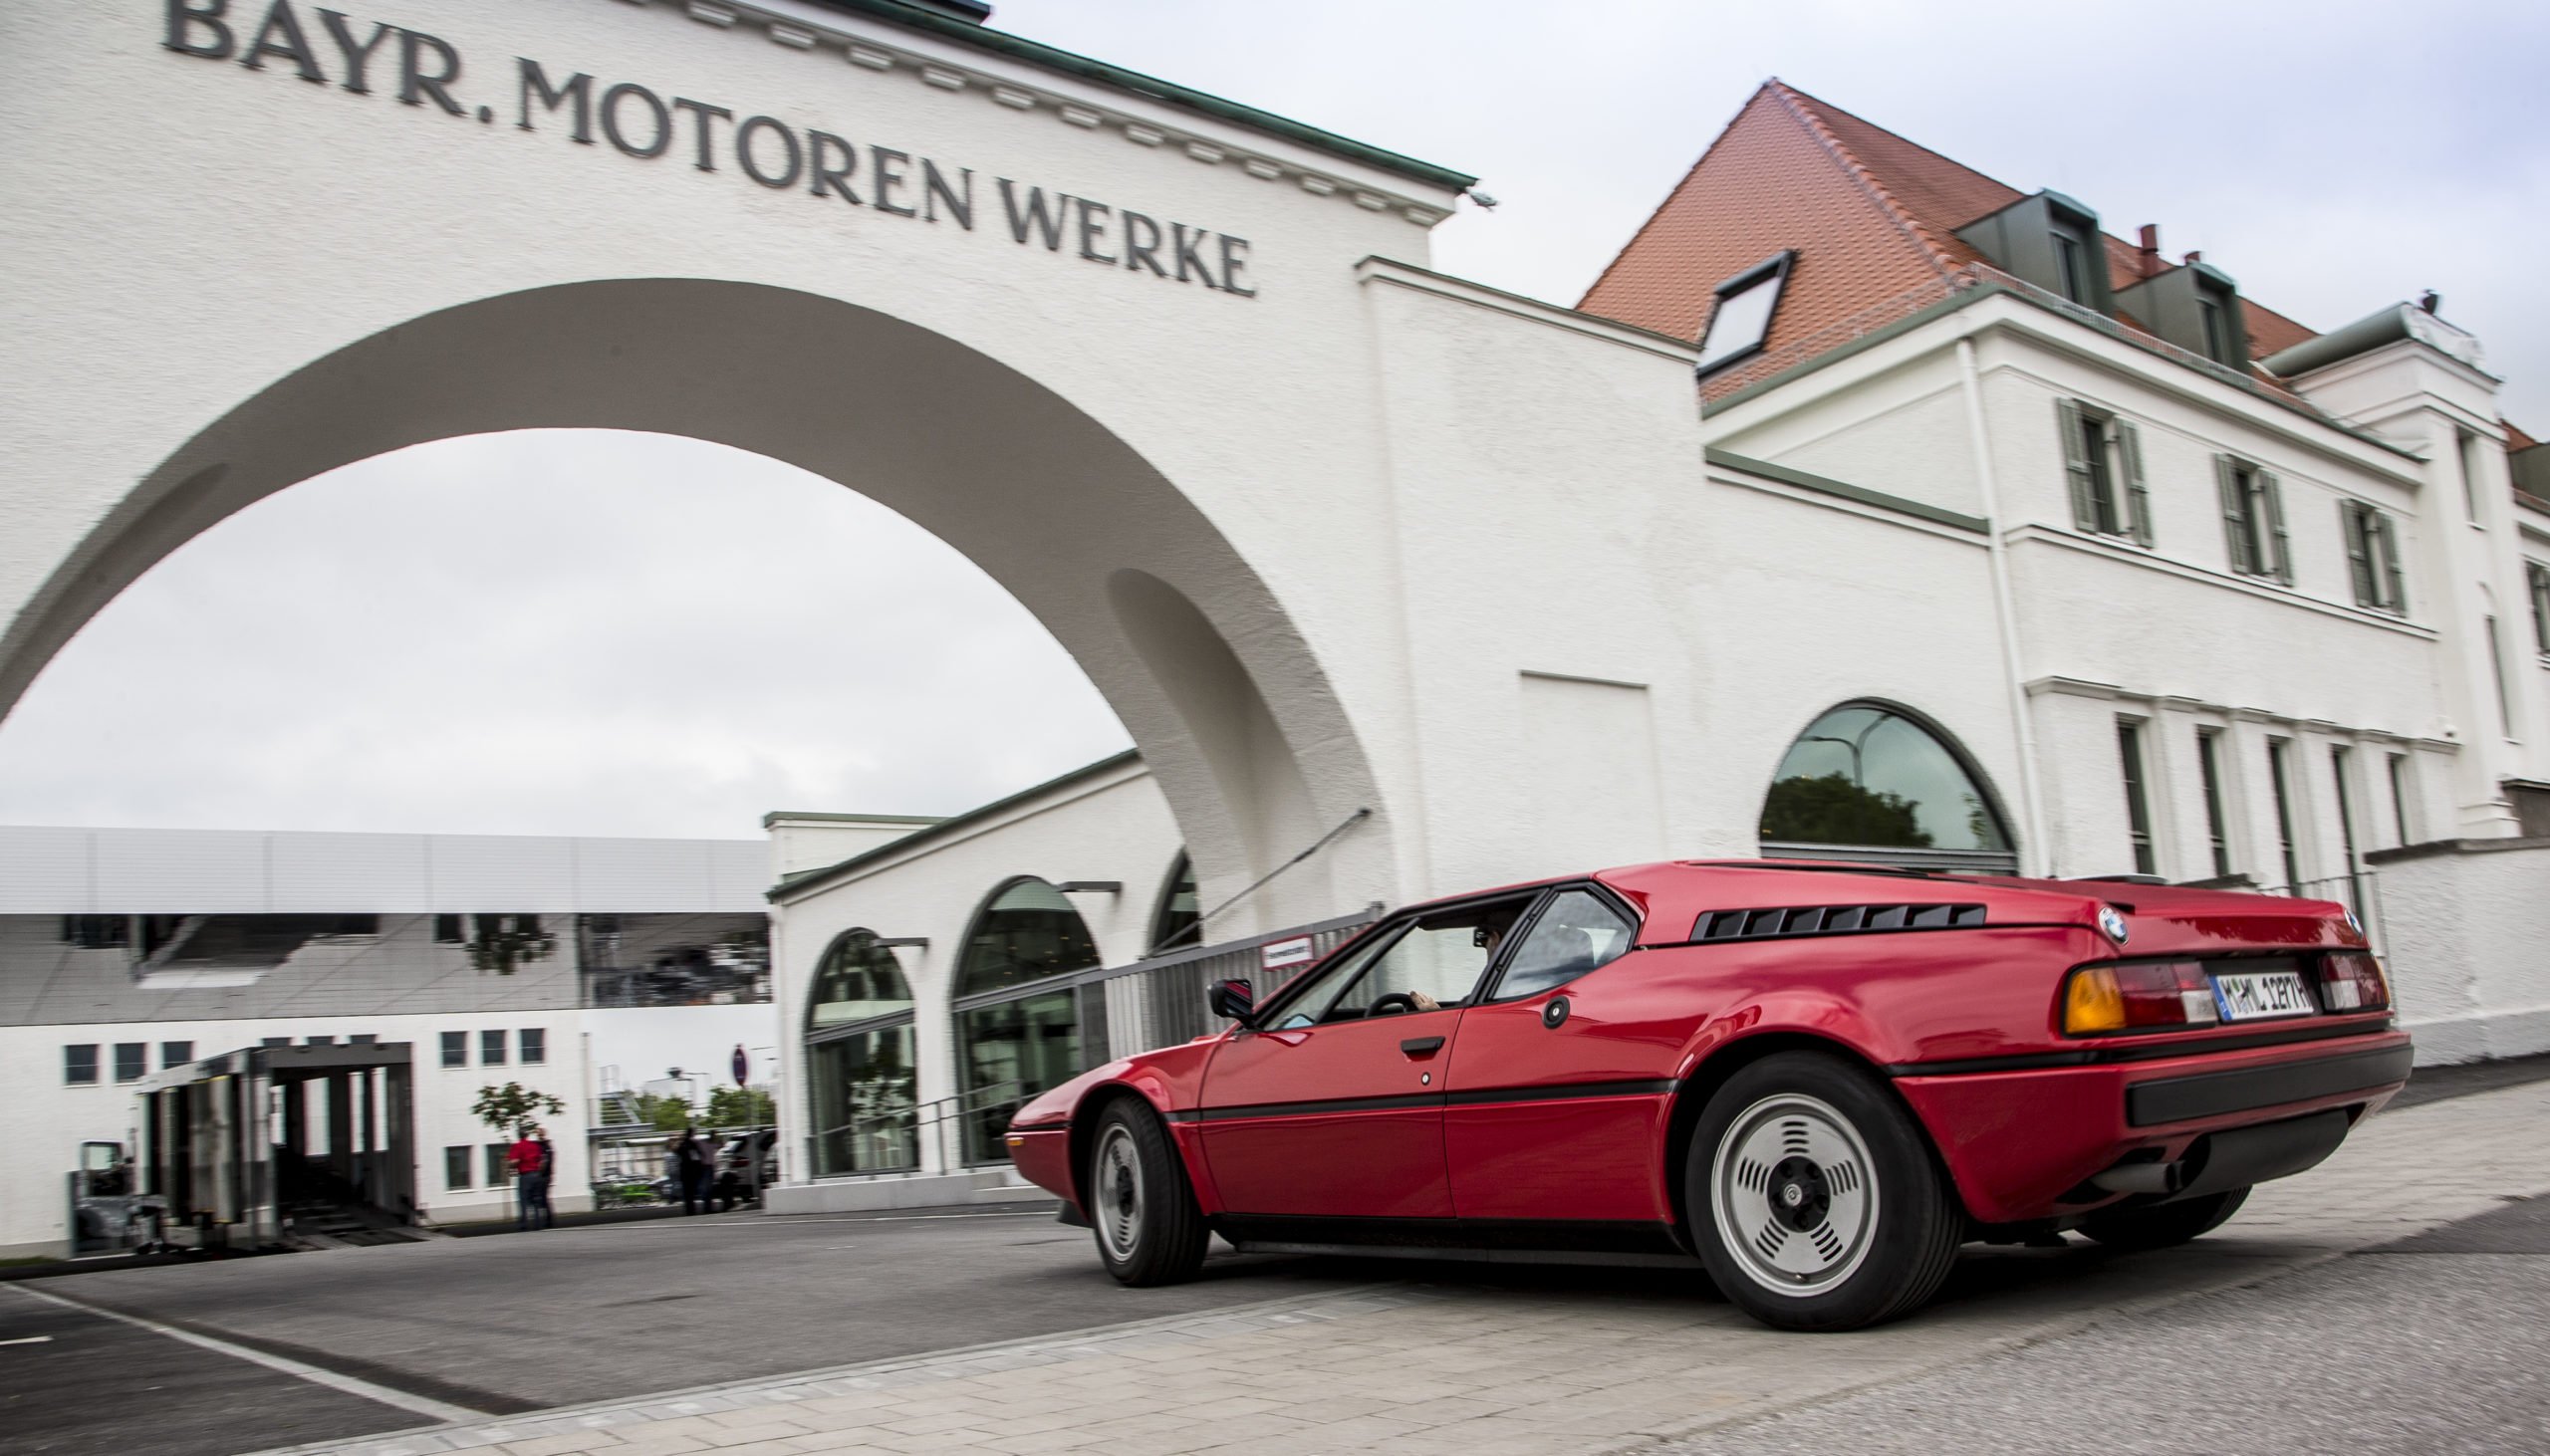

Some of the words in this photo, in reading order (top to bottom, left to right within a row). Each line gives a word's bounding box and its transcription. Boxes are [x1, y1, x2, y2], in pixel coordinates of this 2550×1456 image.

[161, 0, 493, 123] BAYR.
[515, 55, 976, 231] MOTOREN
[996, 176, 1256, 299] WERKE
